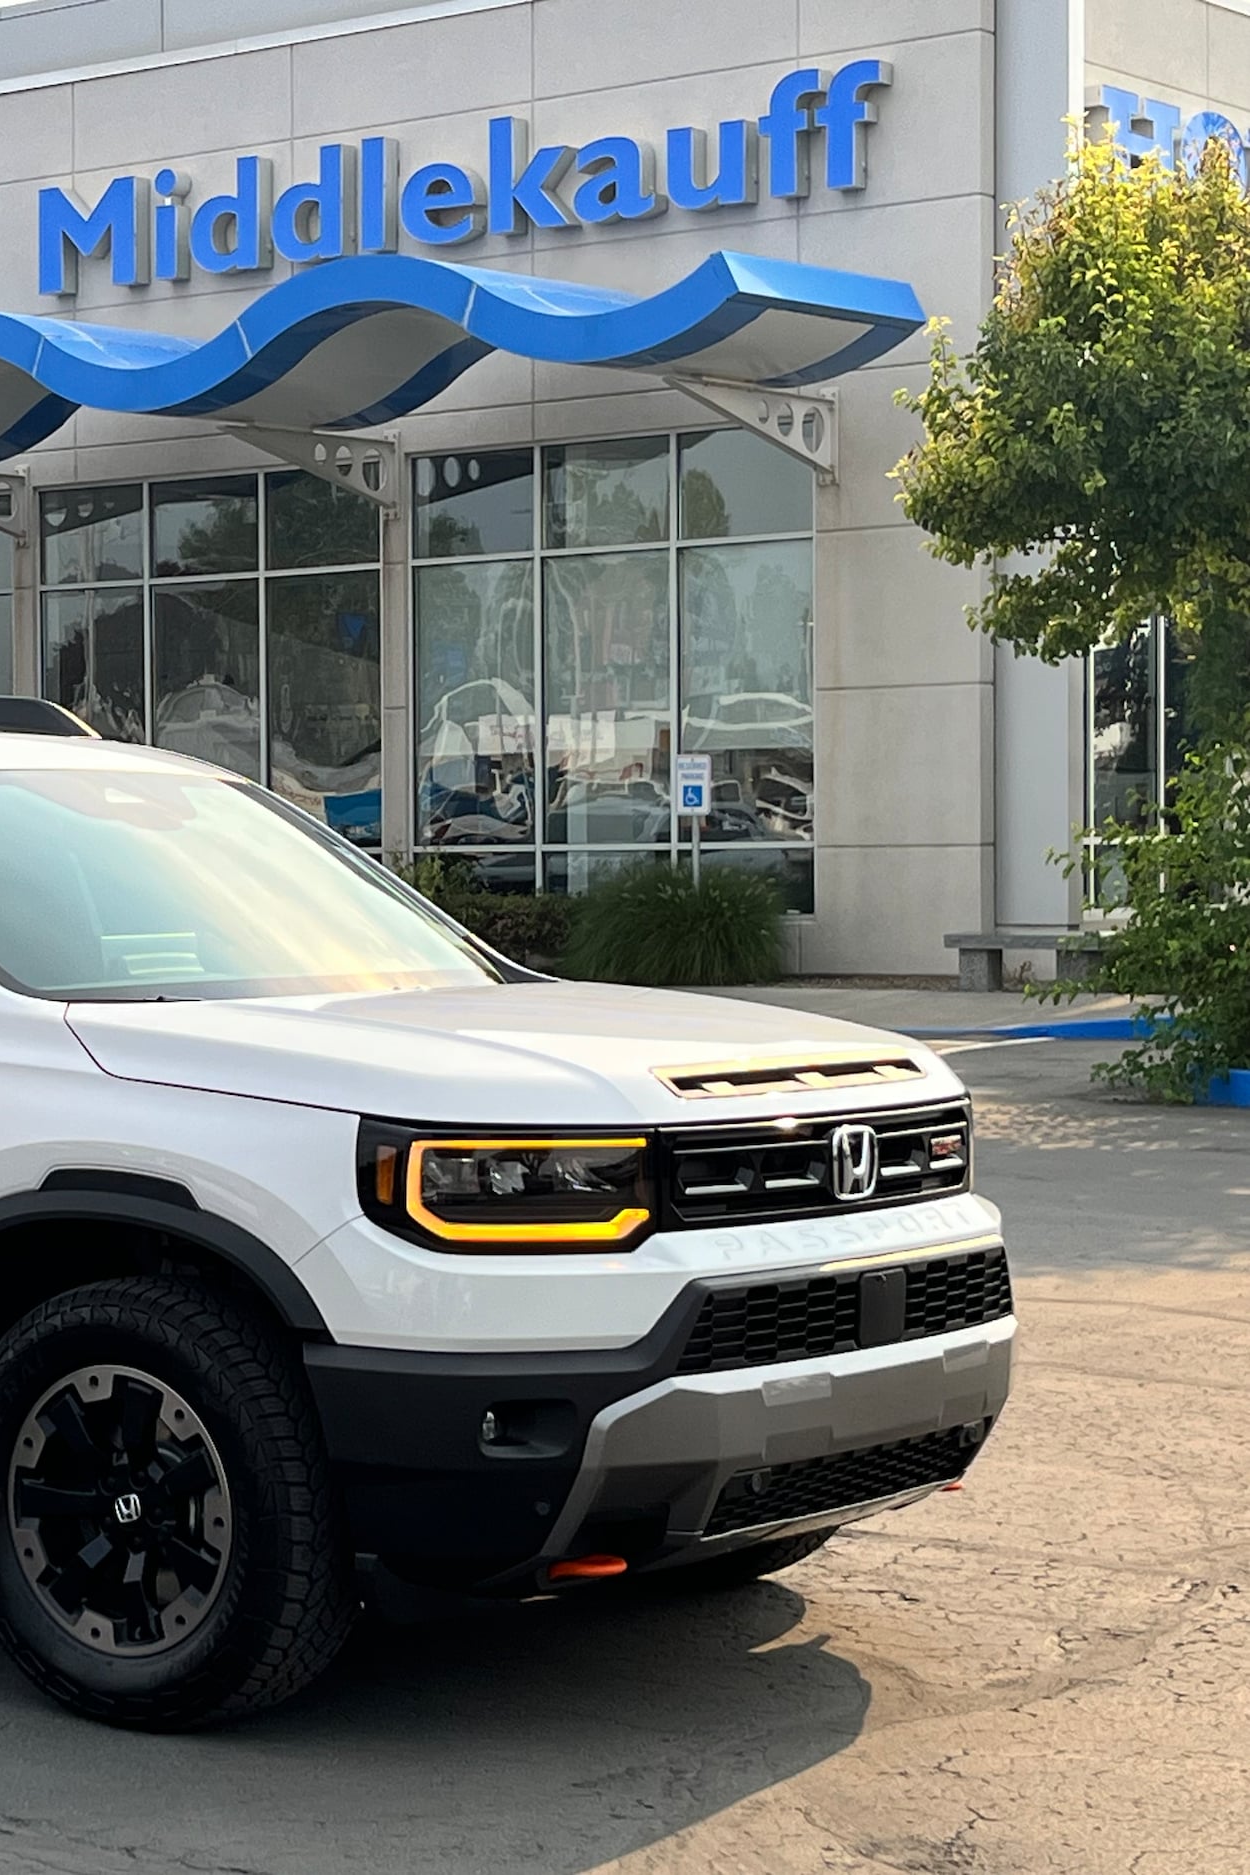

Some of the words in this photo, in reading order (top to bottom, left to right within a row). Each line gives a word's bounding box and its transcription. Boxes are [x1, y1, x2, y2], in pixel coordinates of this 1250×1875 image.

[37, 58, 888, 296] Middlekauff
[1100, 84, 1250, 200] HO
[706, 1201, 971, 1262] PASSPORT
